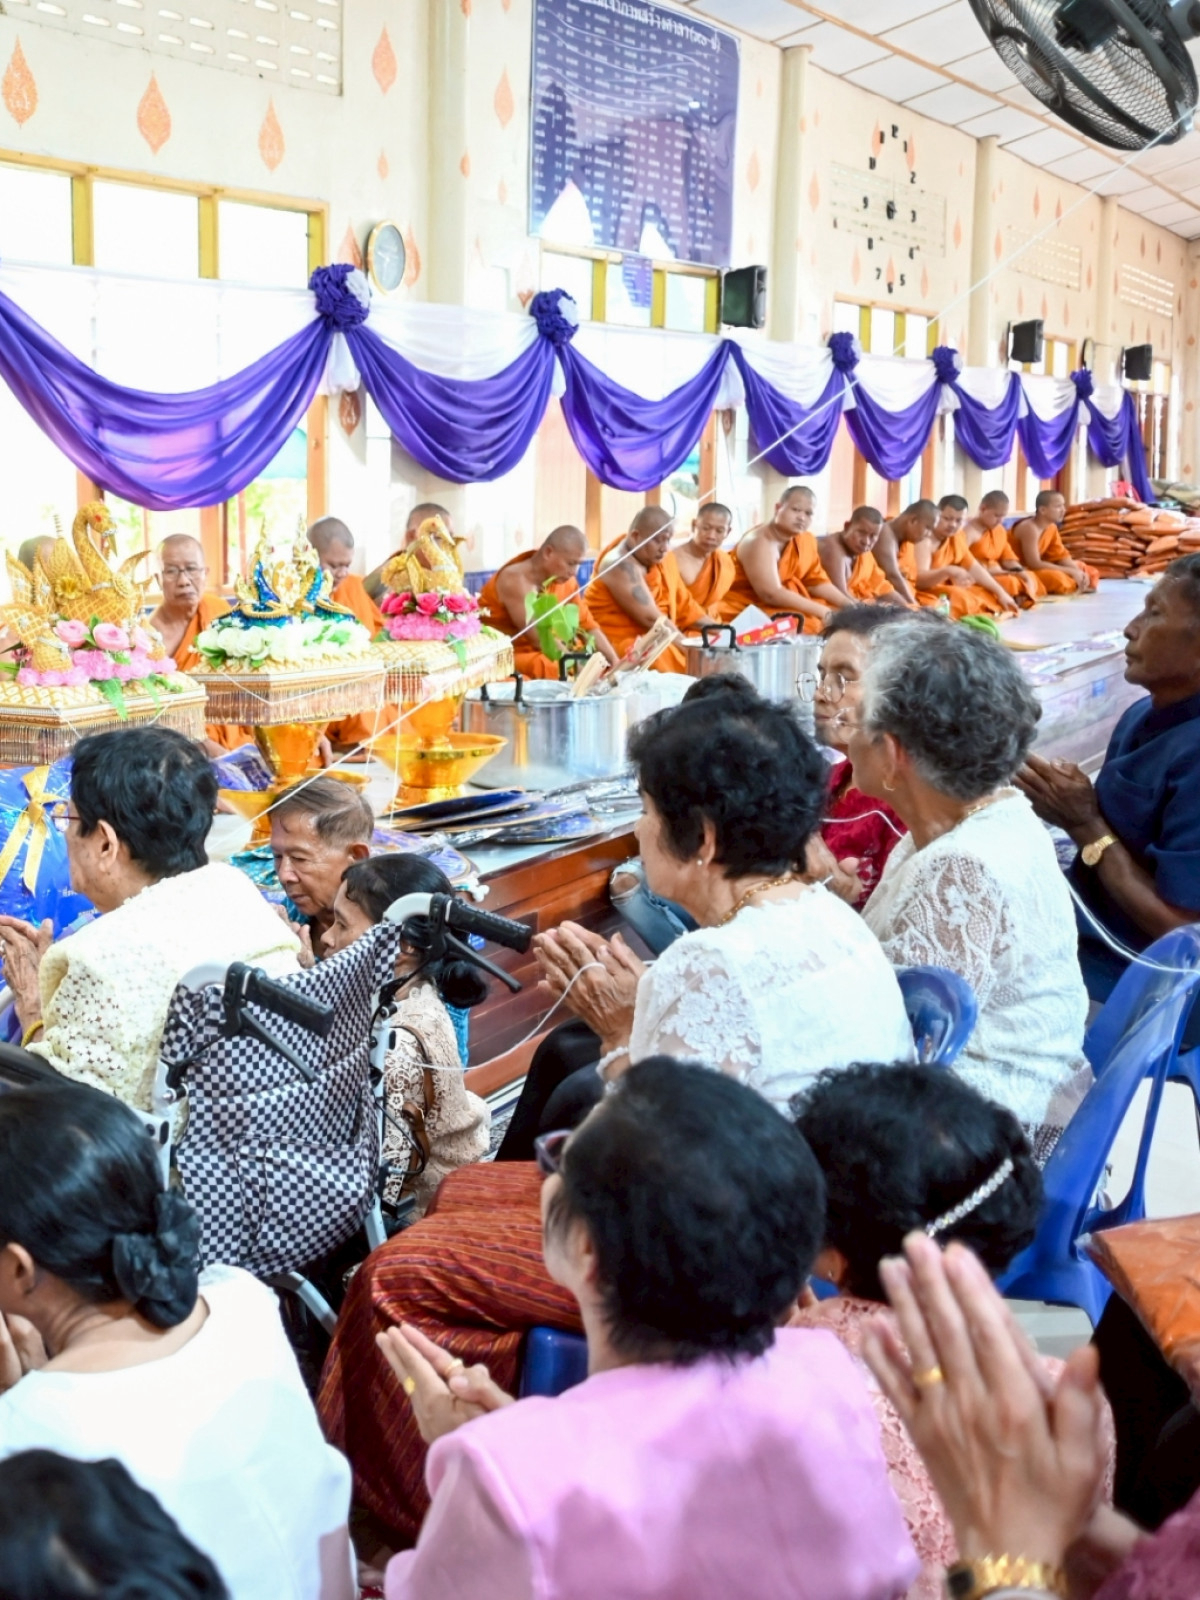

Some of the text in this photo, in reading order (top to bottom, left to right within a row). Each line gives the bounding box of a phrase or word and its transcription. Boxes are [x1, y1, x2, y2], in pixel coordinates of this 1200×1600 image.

[910, 171, 916, 184] 2
[862, 196, 869, 209] 9
[910, 209, 917, 223] 3
[875, 267, 881, 280] 7
[900, 273, 906, 286] 5
